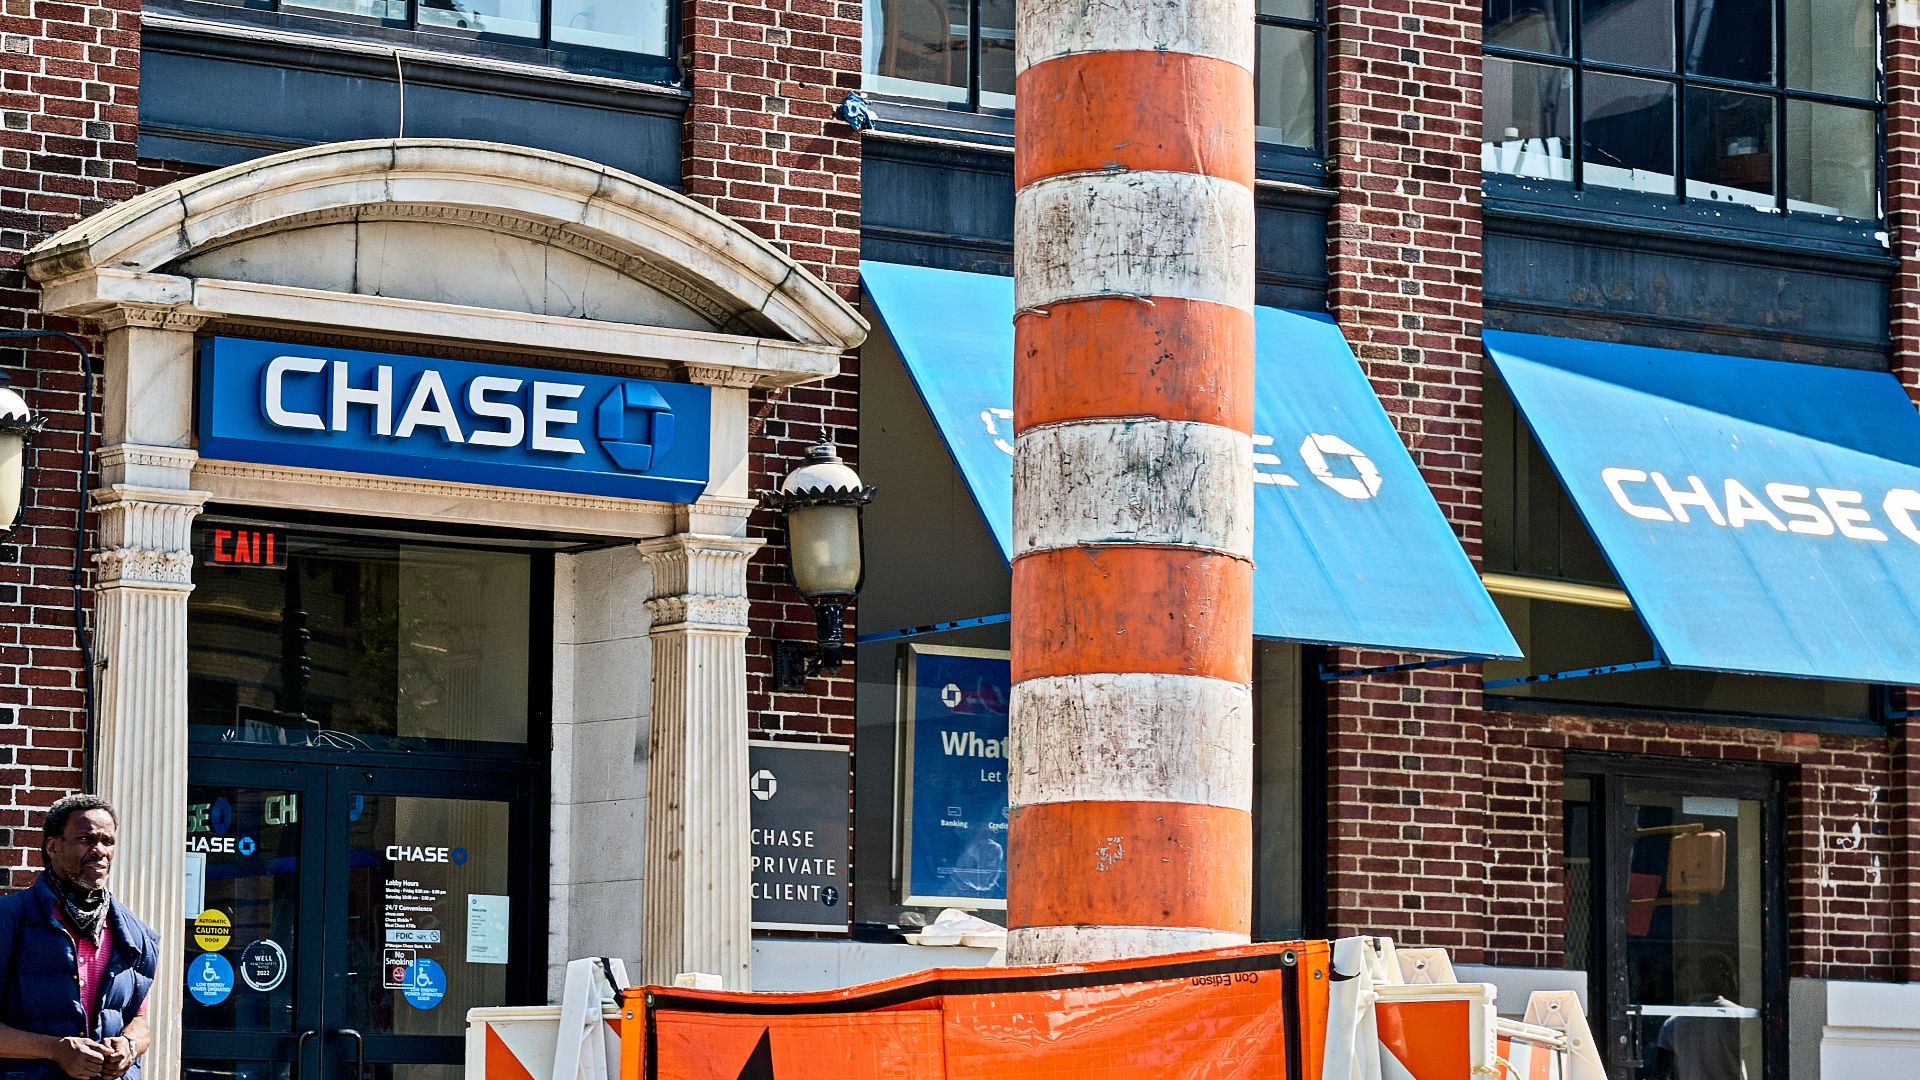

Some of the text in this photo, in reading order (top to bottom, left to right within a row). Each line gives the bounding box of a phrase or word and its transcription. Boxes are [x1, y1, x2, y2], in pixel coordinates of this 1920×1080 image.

[263, 355, 586, 454] CHASE
[1601, 467, 1889, 542] CHASE
[981, 769, 1001, 782] Let
[941, 820, 968, 828] Banking
[751, 829, 814, 847] CHASE
[386, 845, 449, 862] CHASE
[751, 856, 835, 875] PRIVATE
[751, 883, 821, 901] CLIENT
[386, 958, 413, 967] Smoking
[1191, 973, 1258, 986] Con Edison
